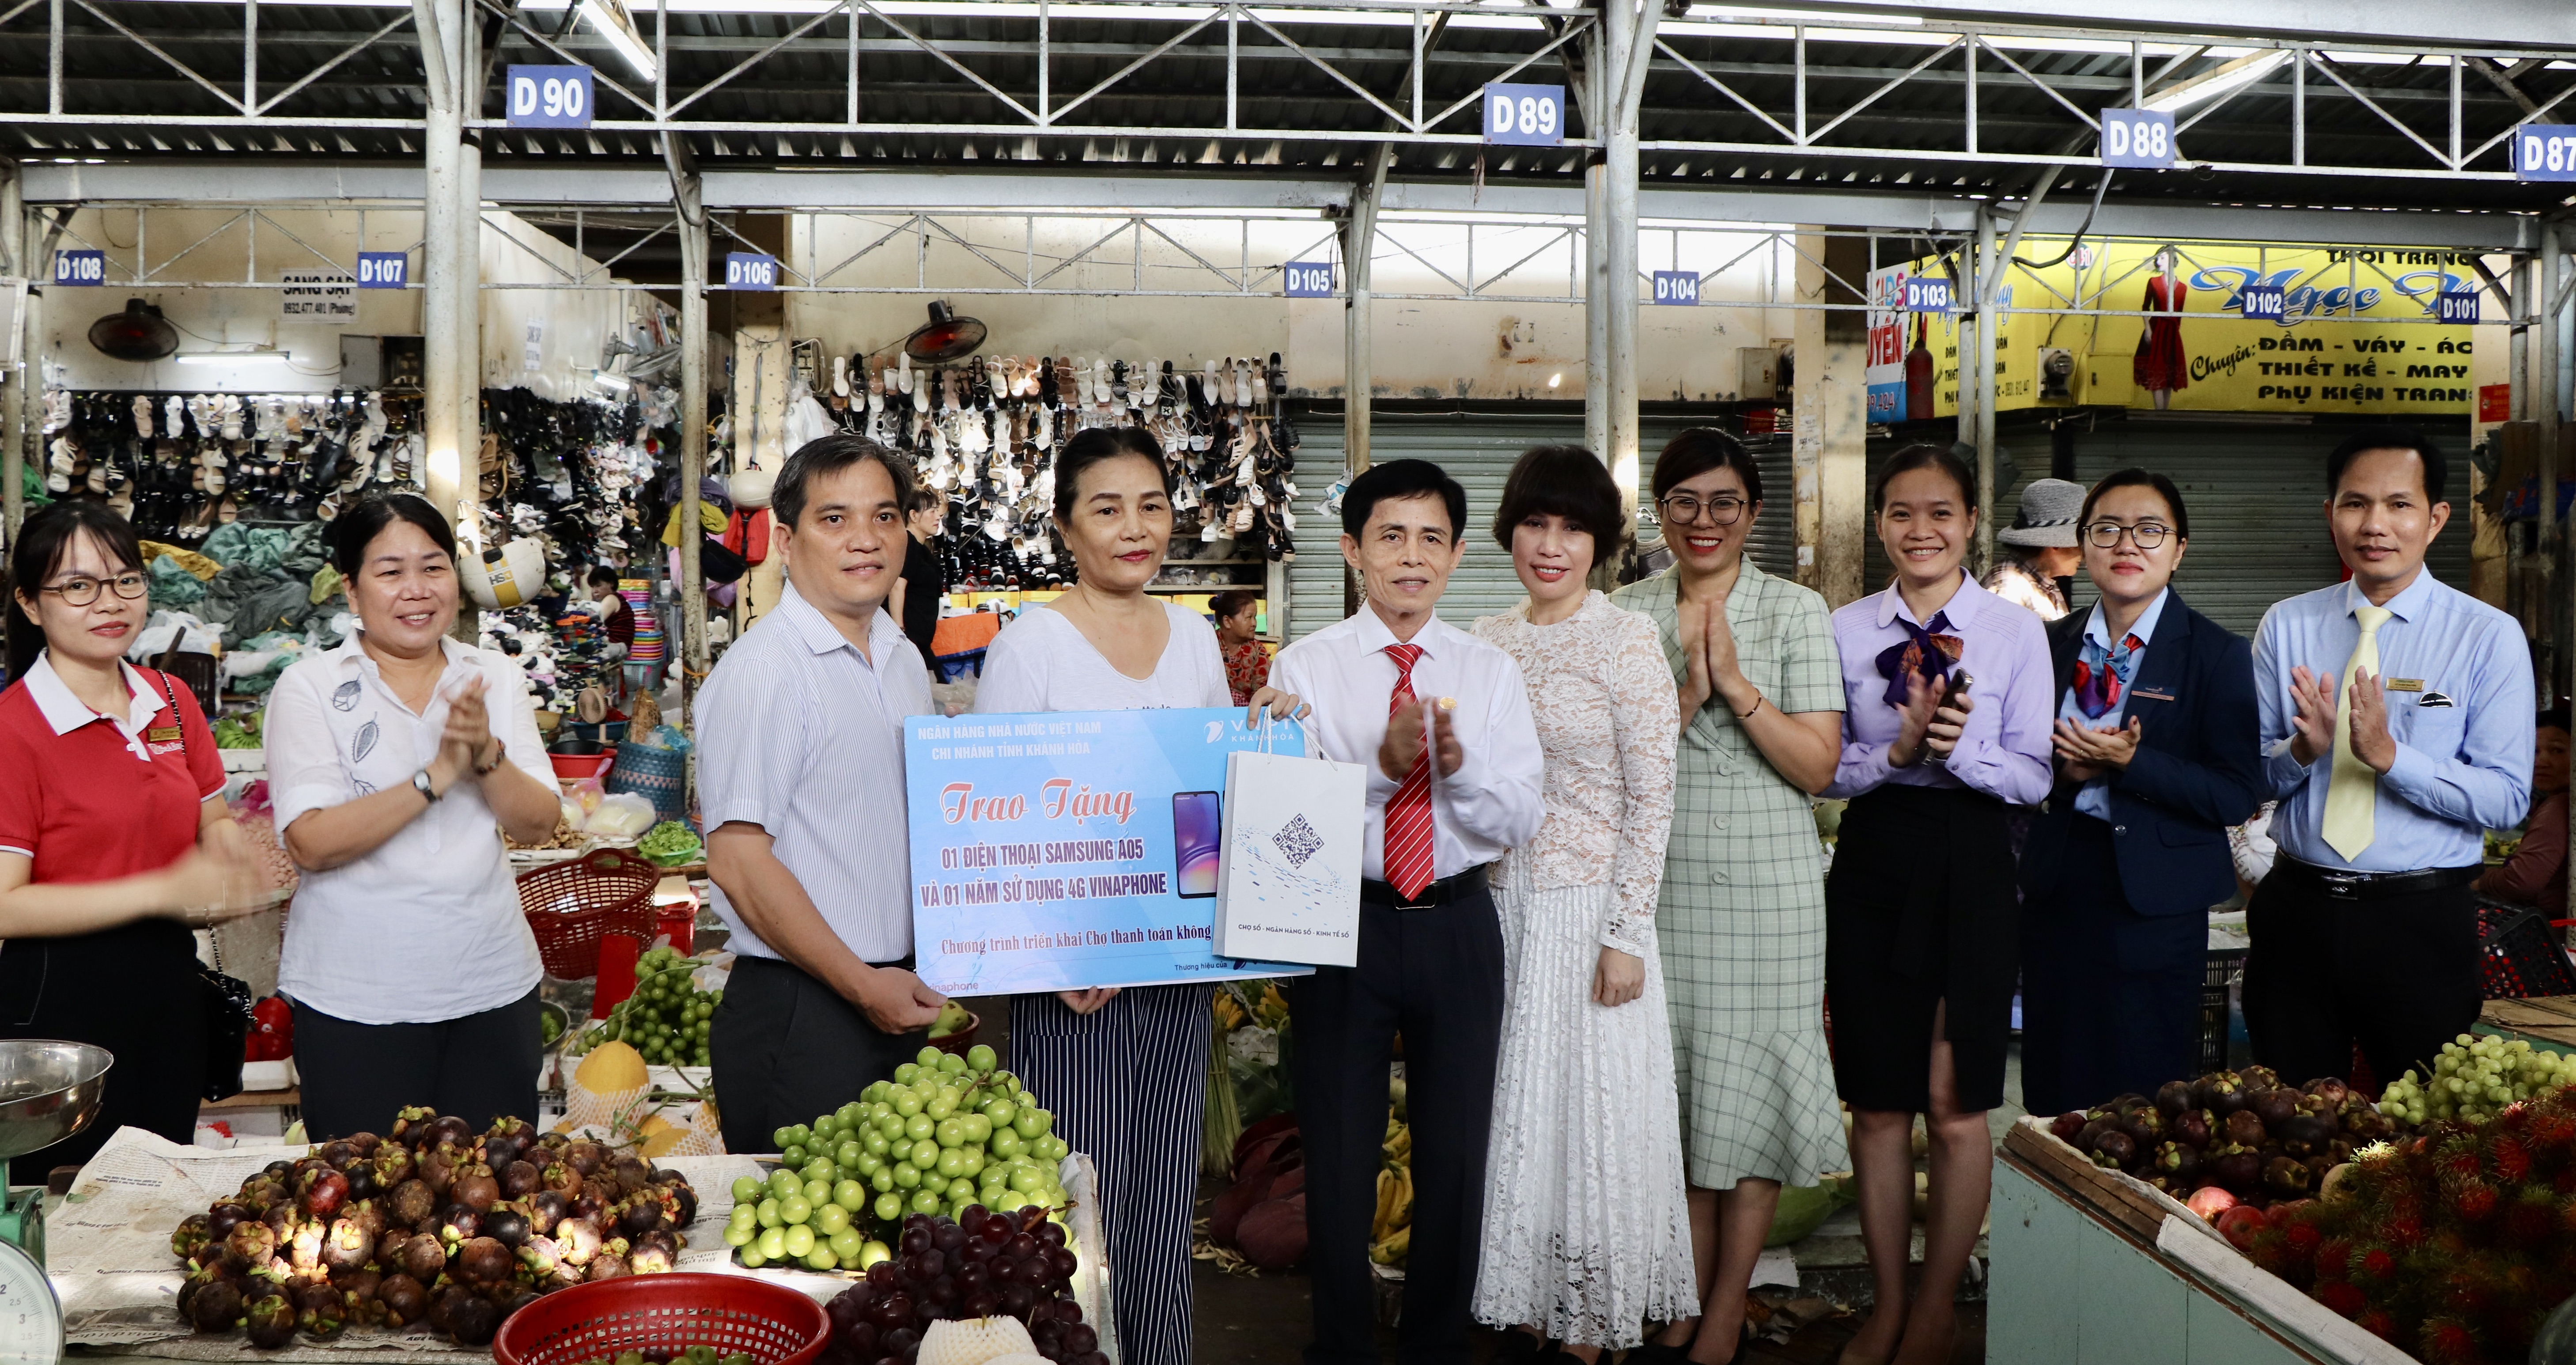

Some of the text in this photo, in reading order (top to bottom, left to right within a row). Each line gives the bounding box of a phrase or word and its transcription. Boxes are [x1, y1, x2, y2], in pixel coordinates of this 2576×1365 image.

[2353, 336, 2405, 353] VÁY
[2258, 356, 2334, 376] THIẾT
[2344, 357, 2376, 376] KẾ
[2406, 365, 2468, 378] MAY
[2322, 383, 2384, 405] KIỆN
[918, 720, 1101, 740] NGÂN HÀNG NHÀ NƯỚC VIỆT NAM
[932, 740, 1090, 760] CHI NHÁNH TỈNH KHÁNH HÒA
[941, 779, 1136, 825] Trao Tặng
[963, 842, 997, 872] ĐIỆN
[1000, 843, 1041, 869] THOẠI
[1045, 839, 1114, 863] SAMSUNG
[1118, 839, 1143, 860] A05
[920, 881, 941, 907] VÀ
[965, 878, 999, 904] NĂM
[1002, 874, 1022, 902] SỬ
[1025, 879, 1064, 905] DỤNG
[1068, 877, 1086, 899] 4G
[1089, 873, 1167, 898] VINAPHONE
[941, 925, 1211, 955] Chương trình triển khai Chợ thanh toán không
[19, 1314, 26, 1324] 3
